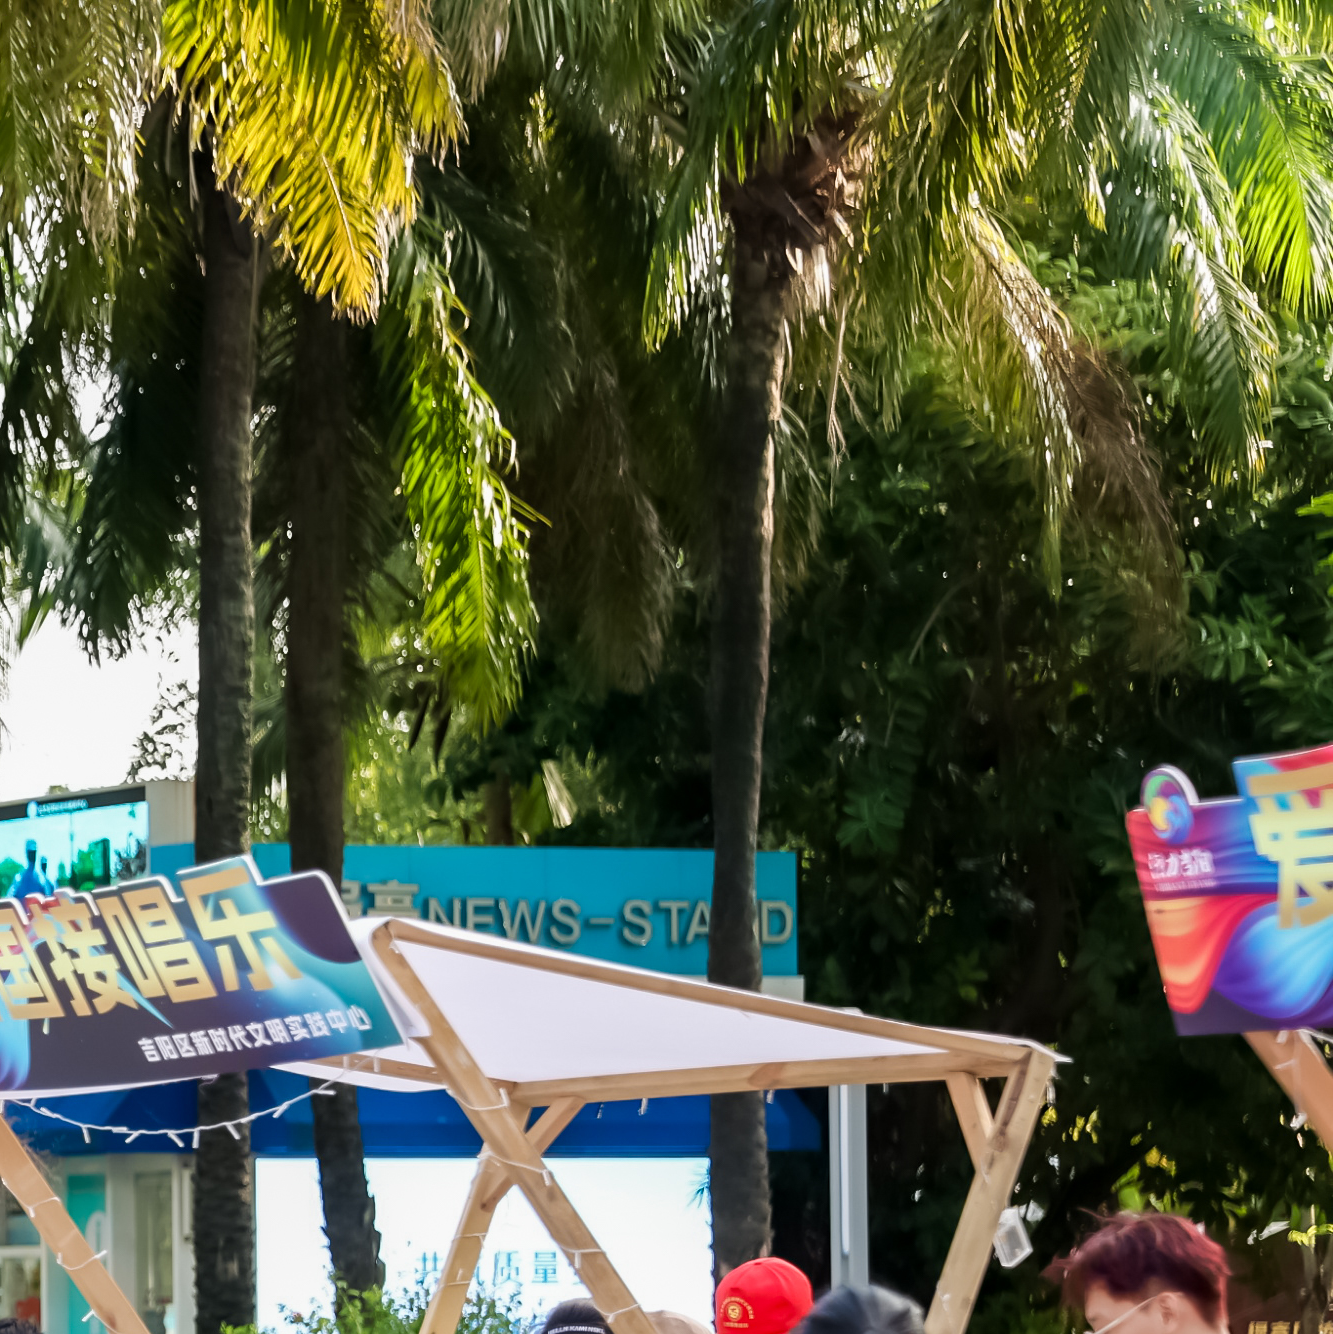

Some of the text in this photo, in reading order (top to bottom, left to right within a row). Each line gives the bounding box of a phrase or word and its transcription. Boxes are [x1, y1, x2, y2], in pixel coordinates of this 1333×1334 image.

[428, 896, 795, 945] NEWS-STAD
[138, 1005, 372, 1063] 吉阳区新时代文明实践中心
